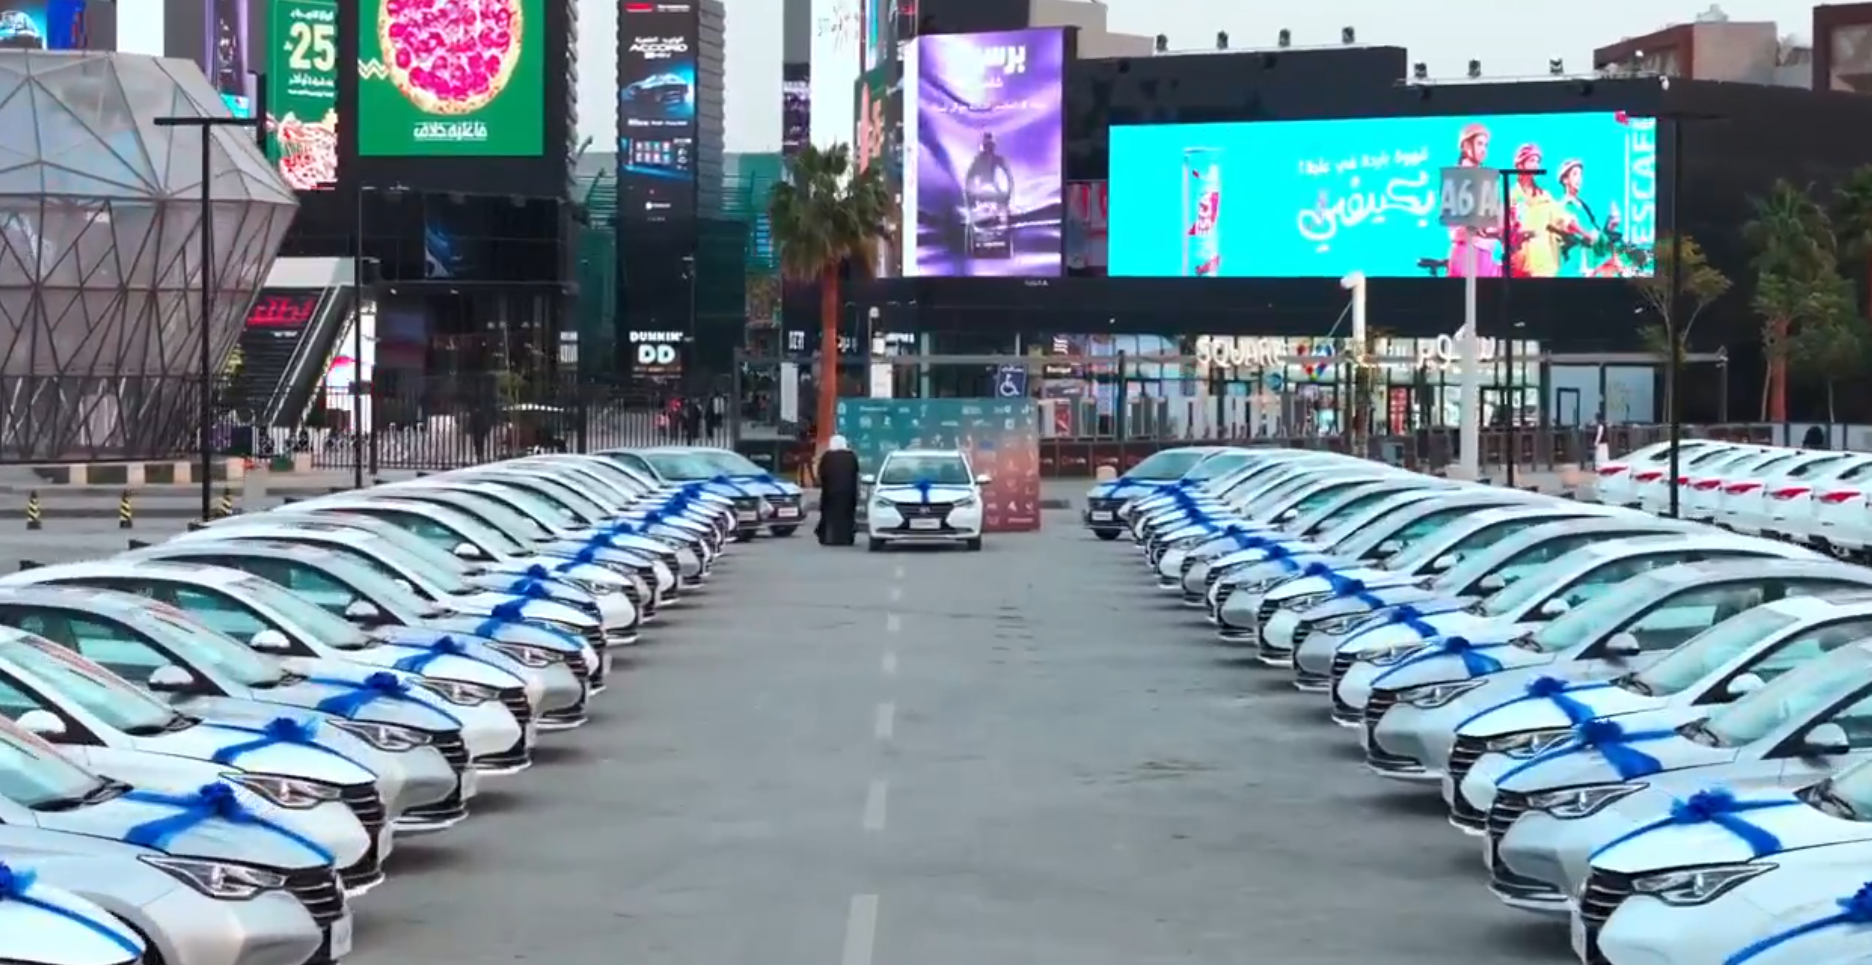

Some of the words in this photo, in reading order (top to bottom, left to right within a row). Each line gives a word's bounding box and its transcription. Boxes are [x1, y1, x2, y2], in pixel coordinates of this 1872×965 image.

[289, 22, 335, 71] 25
[629, 44, 689, 52] ACCORD
[1441, 180, 1474, 216] A6
[1479, 181, 1499, 216] A
[629, 331, 683, 342] DUNKIN'
[638, 344, 675, 364] DD
